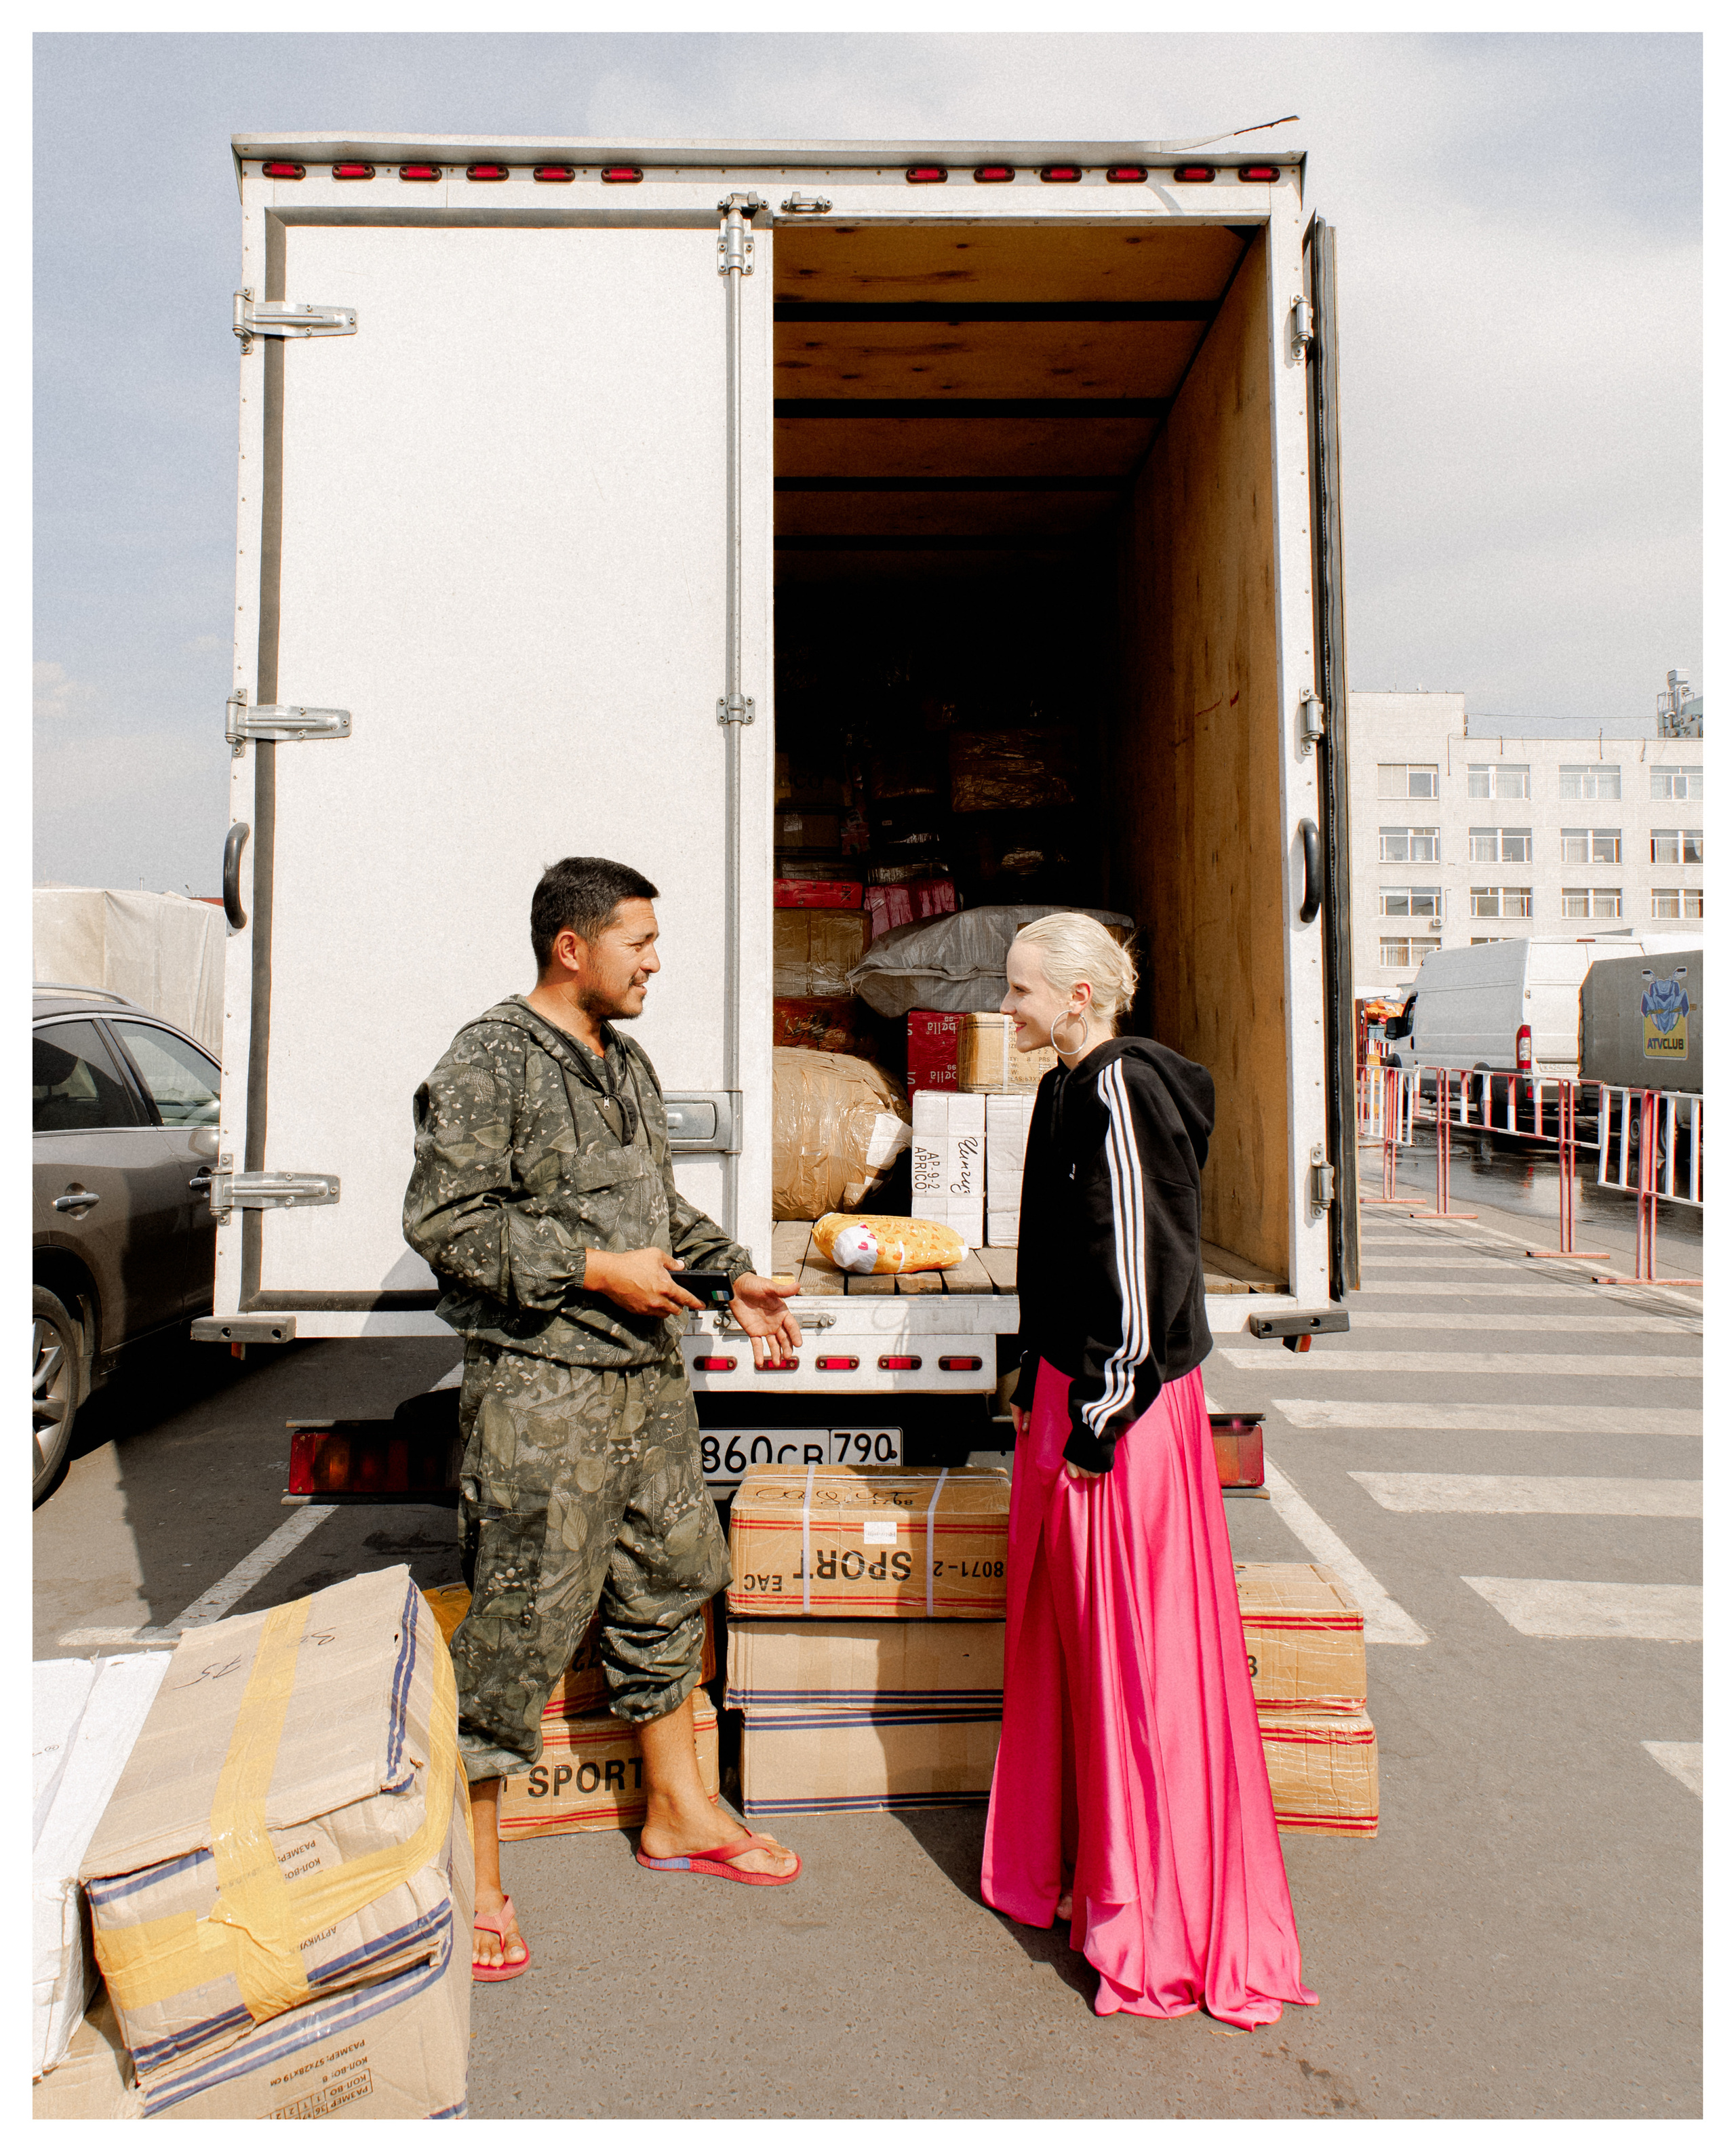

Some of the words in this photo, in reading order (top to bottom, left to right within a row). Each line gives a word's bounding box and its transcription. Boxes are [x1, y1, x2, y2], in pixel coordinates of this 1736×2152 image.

[928, 1022, 956, 1035] bella
[1646, 1037, 1684, 1050] ATVCLUB
[915, 1147, 927, 1193] APRICO
[927, 1152, 941, 1189] AP-9-2
[834, 1433, 892, 1462] 790
[793, 1549, 912, 1582] SPORT
[933, 1561, 1004, 1578] 8071-2
[743, 1574, 783, 1592] EAC
[528, 1757, 643, 1799] SPORT
[277, 1839, 316, 1862] РАЗМЕР:
[285, 1858, 321, 1879] КОЛ-ВО:
[326, 2039, 365, 2061] РАЗМЕР:
[332, 2056, 368, 2077] КОЛ-ВО:
[330, 2073, 367, 2096] КОЛ-ВО
[331, 2085, 368, 2108] РАЗМЕР
[315, 2105, 326, 2115] 36
